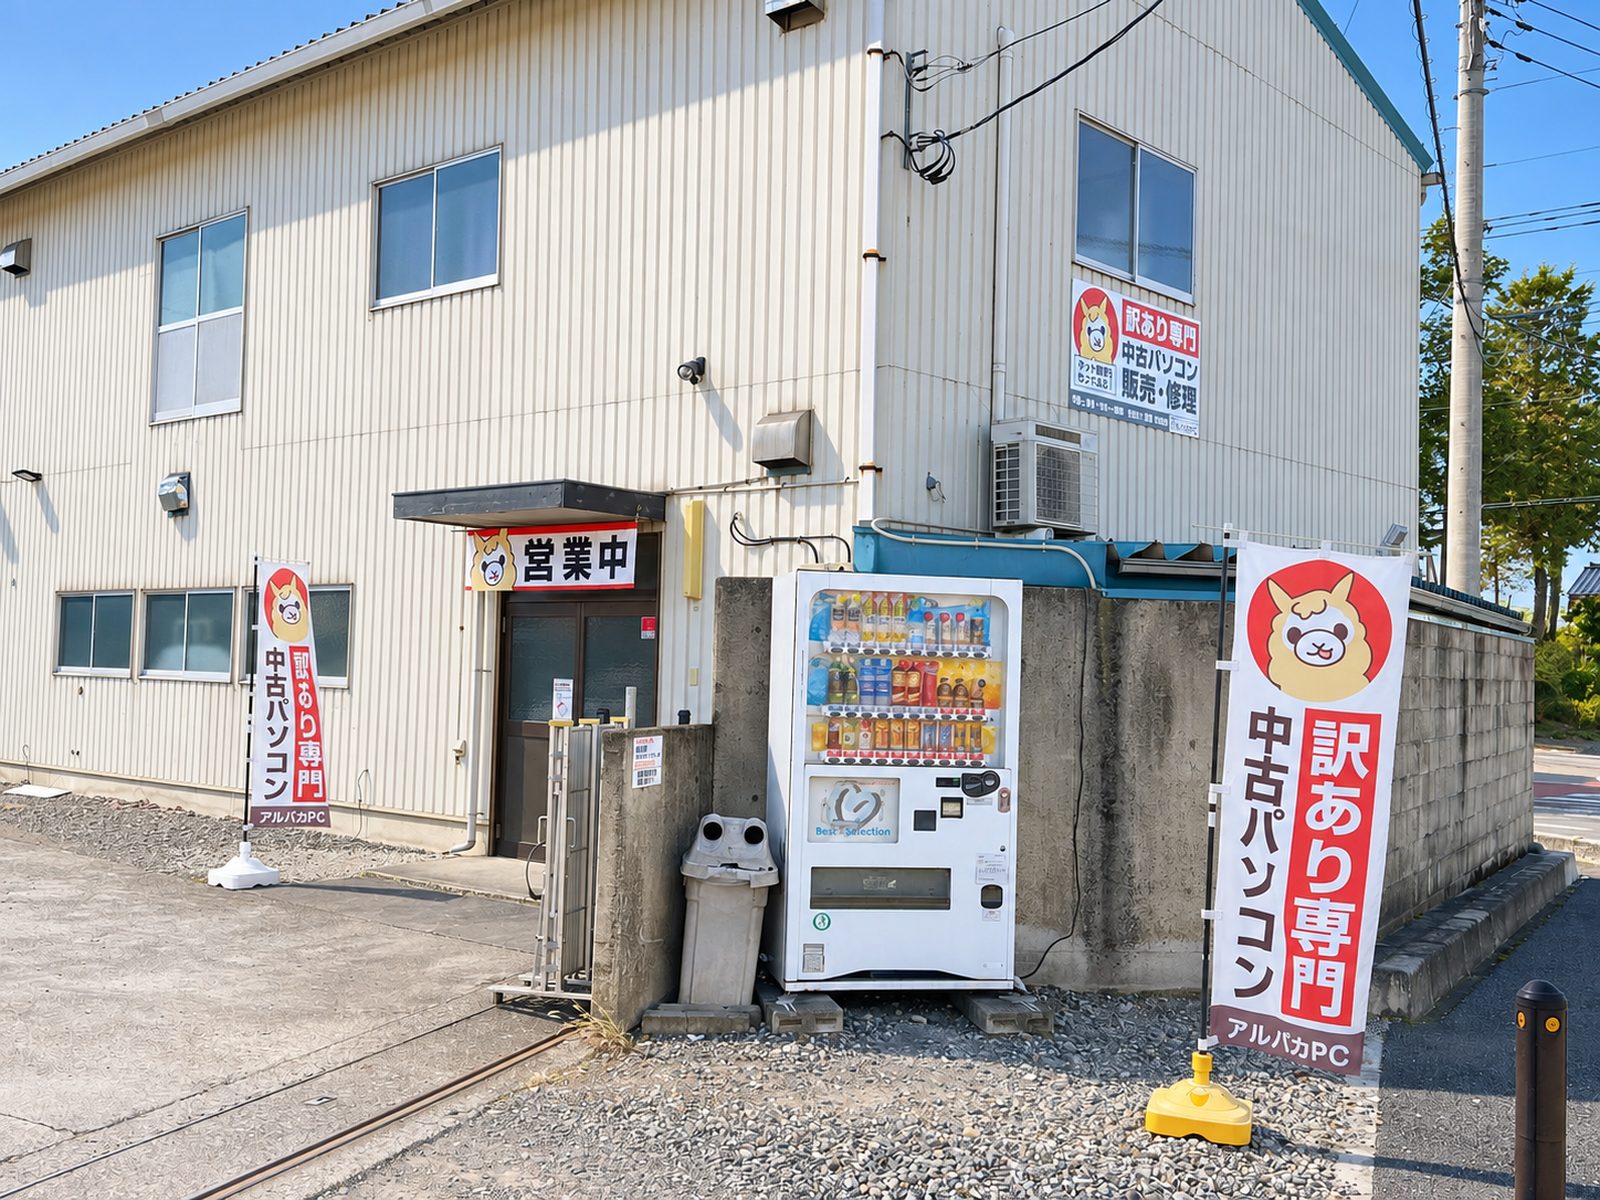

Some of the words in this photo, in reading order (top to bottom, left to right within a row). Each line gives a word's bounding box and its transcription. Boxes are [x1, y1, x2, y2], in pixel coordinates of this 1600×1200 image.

[1125, 305, 1197, 352] 訳あり専門
[1121, 341, 1198, 382] 中古パソコン
[1121, 368, 1197, 415] 販売・修理
[524, 534, 628, 582] 営業中
[264, 646, 289, 800] 中古パソコン
[293, 651, 324, 798] 訳あり専門
[815, 826, 837, 836] Best
[845, 826, 891, 836] Selection
[1234, 706, 1293, 998] 中古パソコン
[1290, 719, 1371, 1018] 訳あり専門
[1227, 1017, 1349, 1067] アルパカPC
